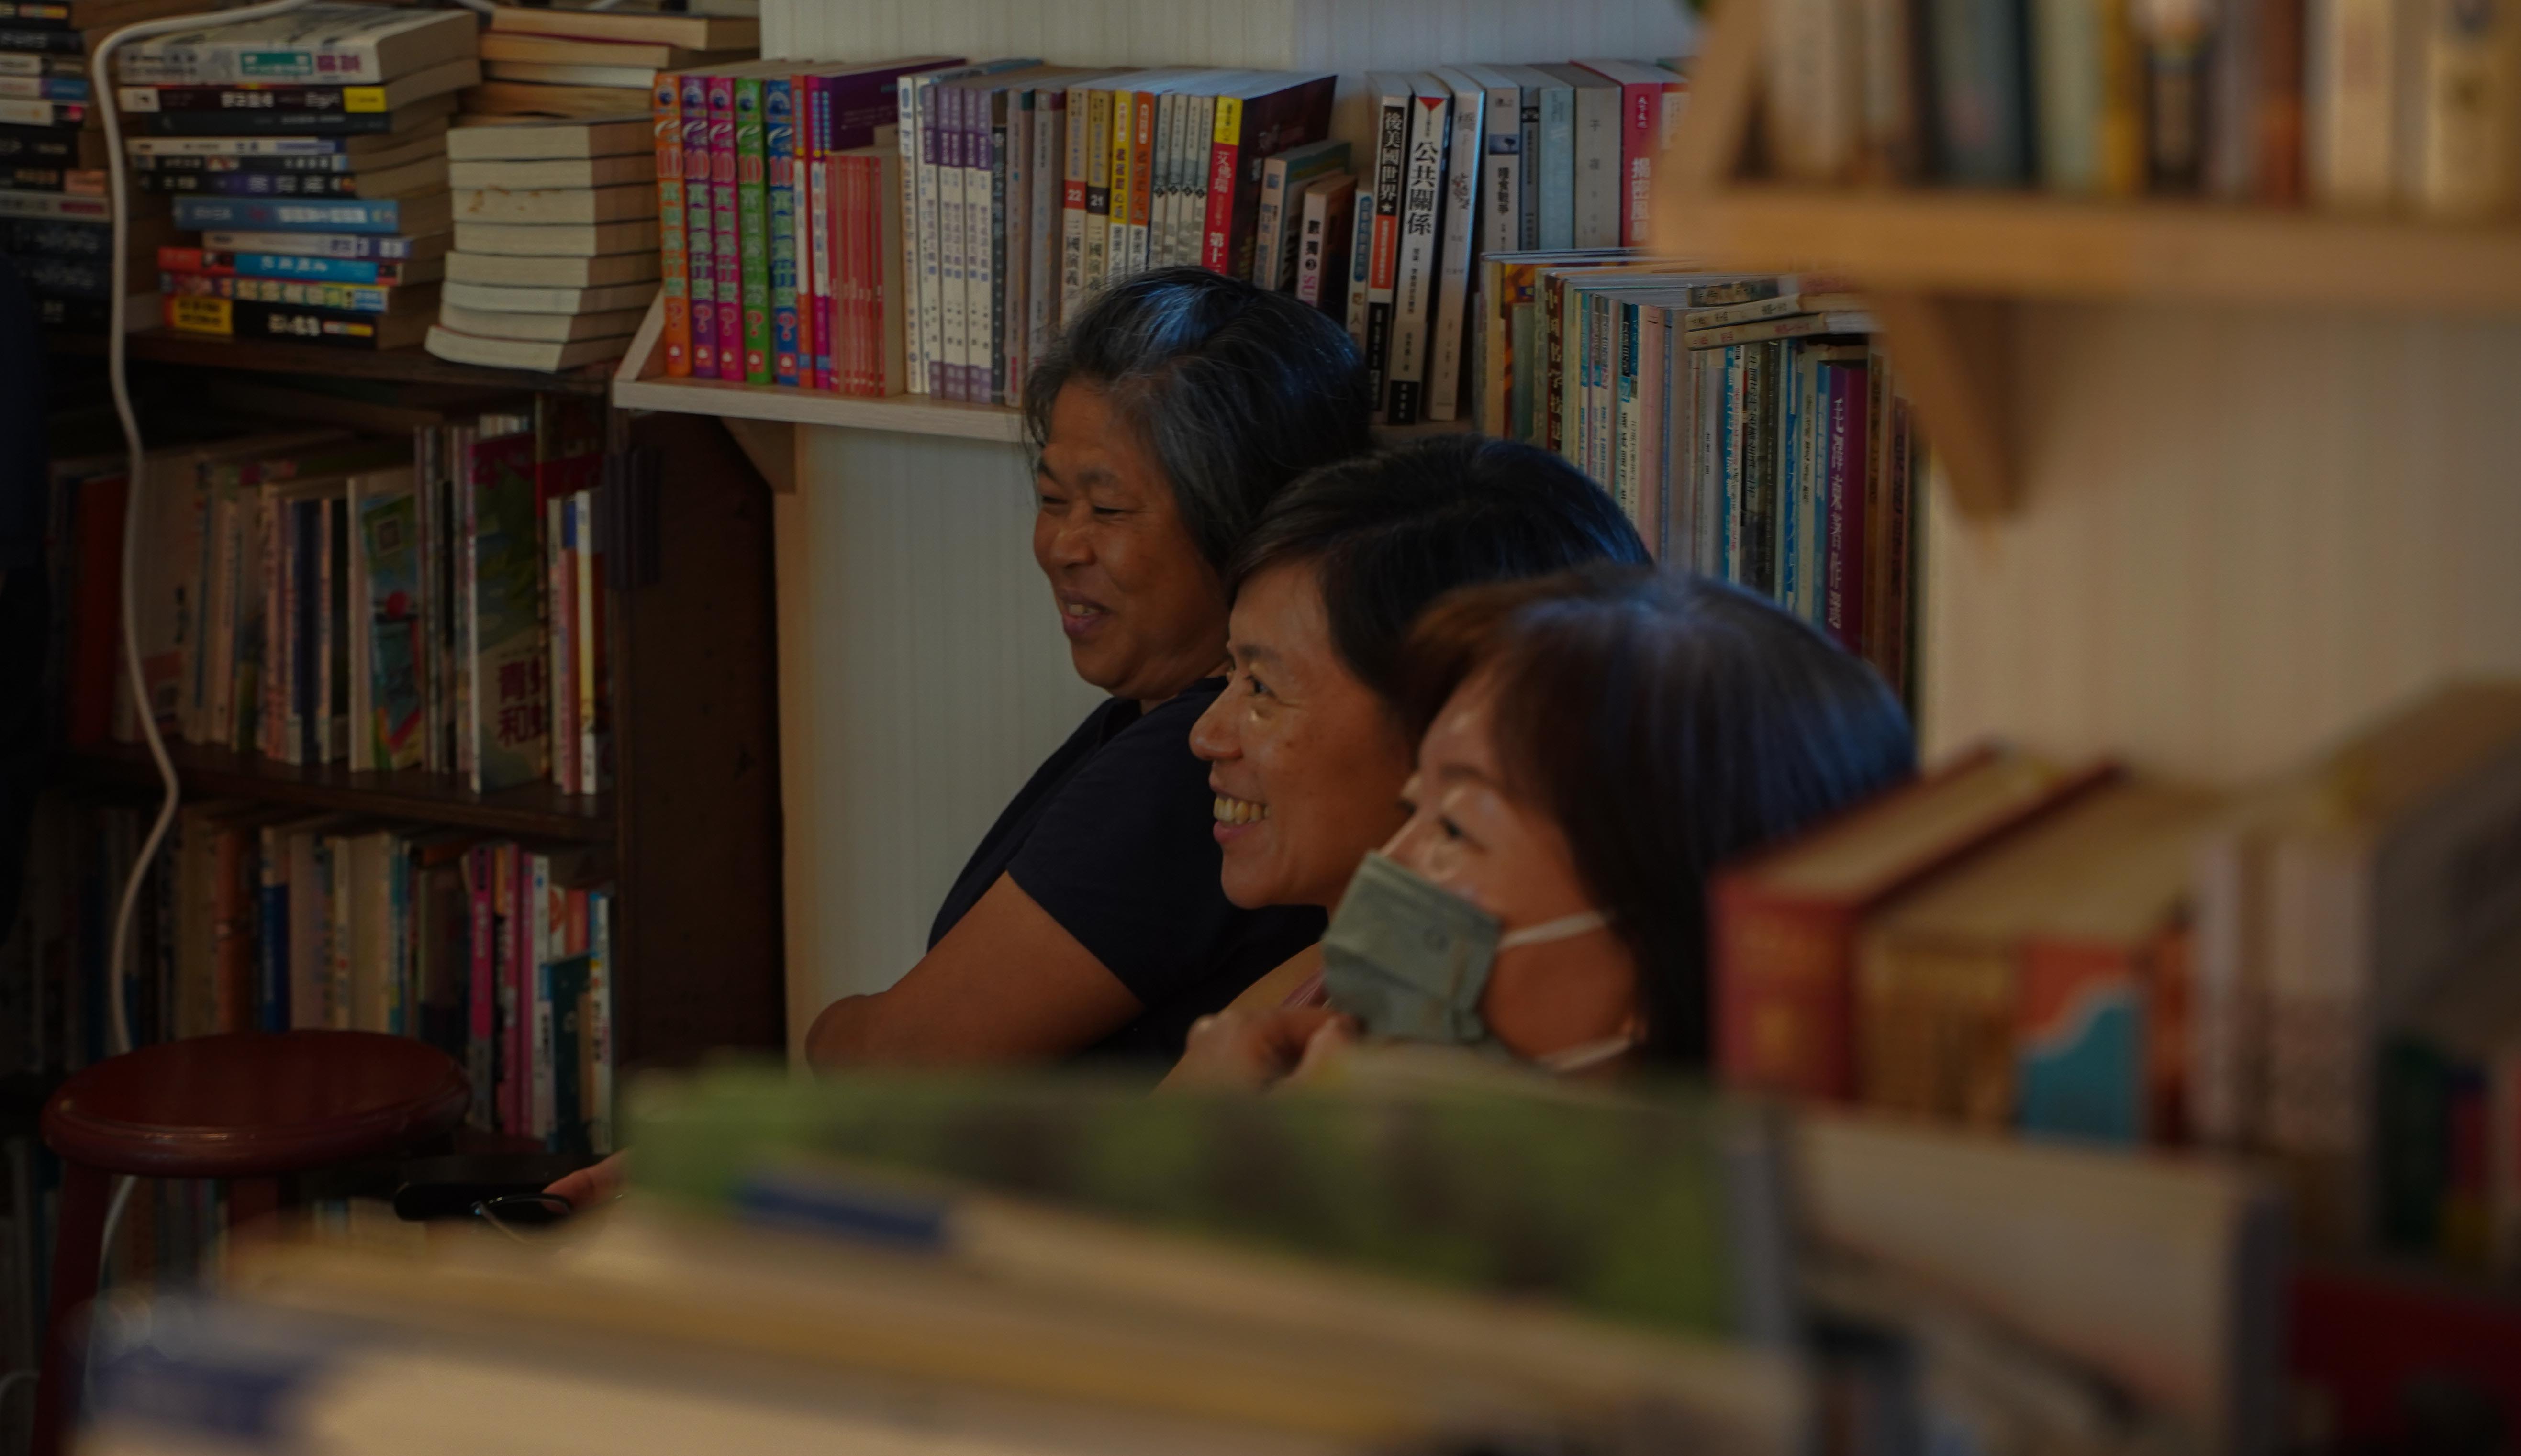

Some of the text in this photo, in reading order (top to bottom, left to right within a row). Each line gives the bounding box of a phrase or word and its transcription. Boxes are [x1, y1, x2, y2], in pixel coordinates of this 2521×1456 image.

[1408, 142, 1438, 235] 公共關係
[1067, 189, 1082, 202] 22
[1090, 194, 1104, 207] 21
